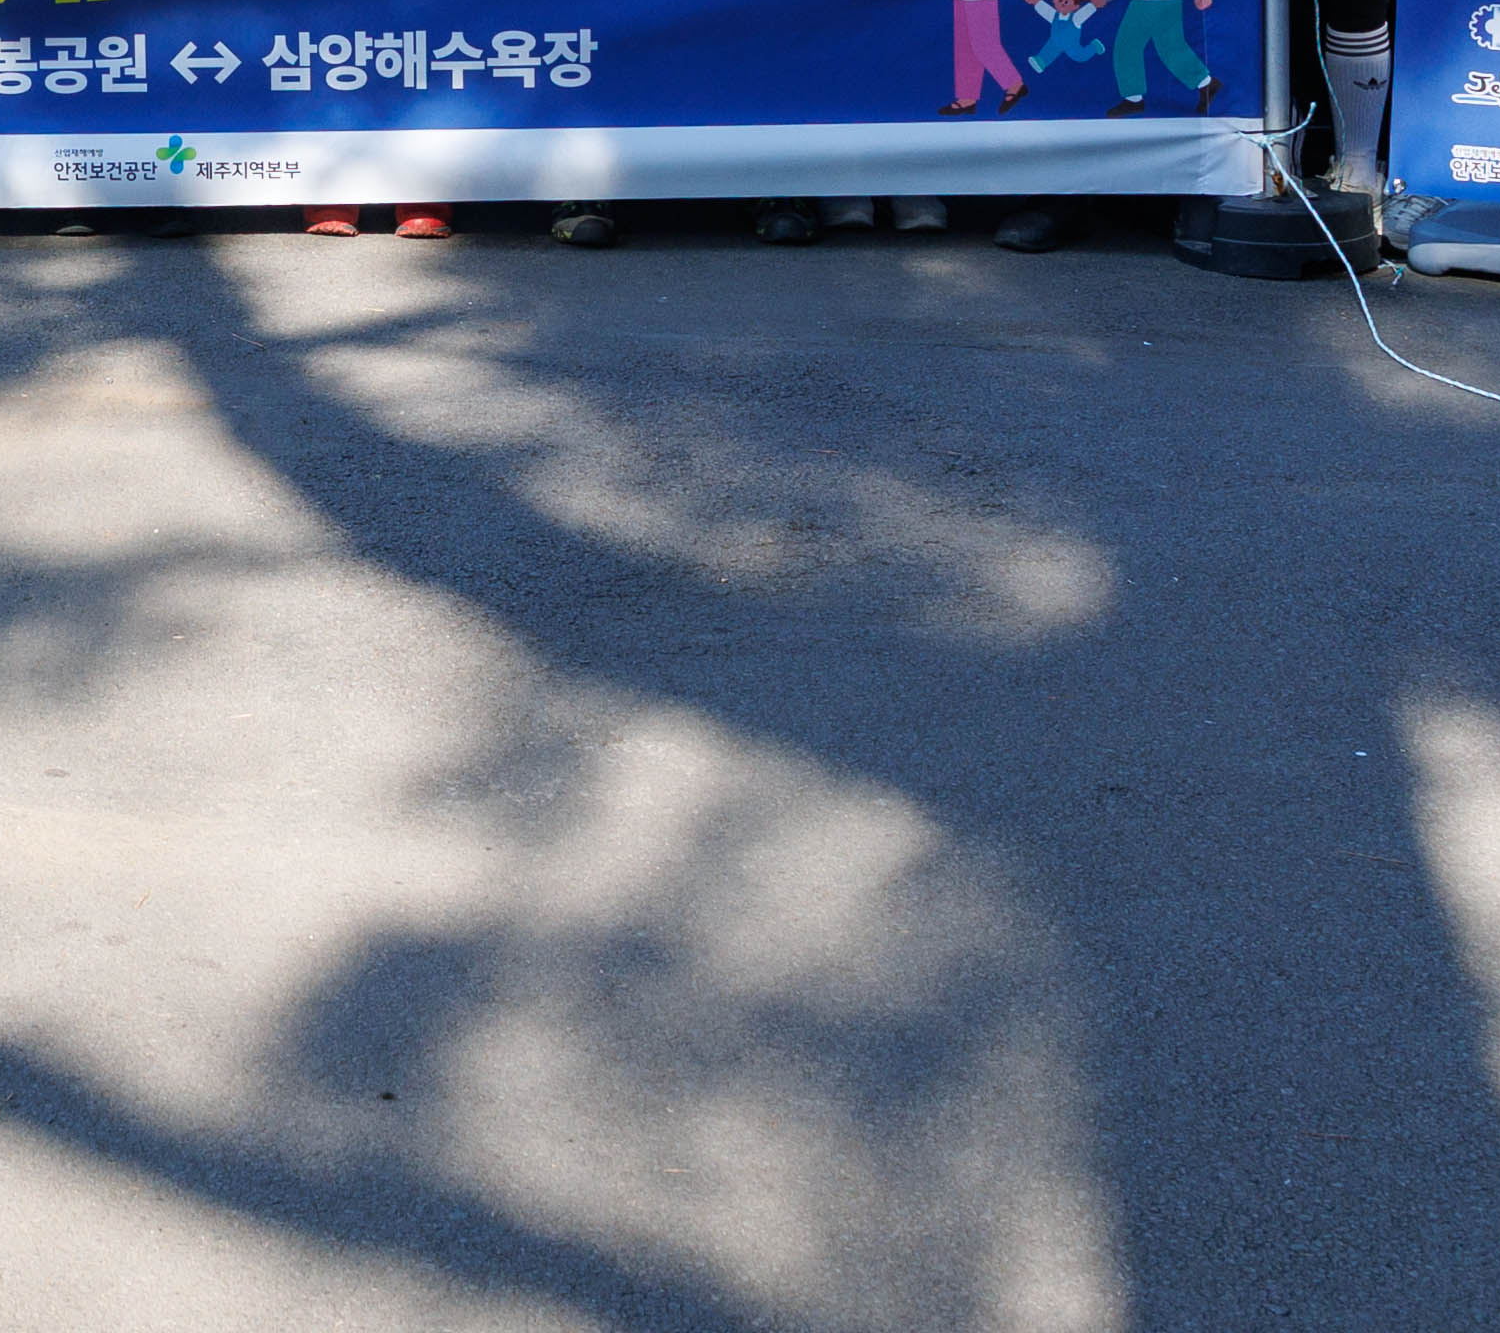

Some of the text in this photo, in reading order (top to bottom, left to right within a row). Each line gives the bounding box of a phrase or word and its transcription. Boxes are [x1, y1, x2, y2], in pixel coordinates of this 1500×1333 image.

[262, 28, 599, 93] 삼양해수욕장
[53, 160, 302, 181] 안전보건공단 제주지역본부
